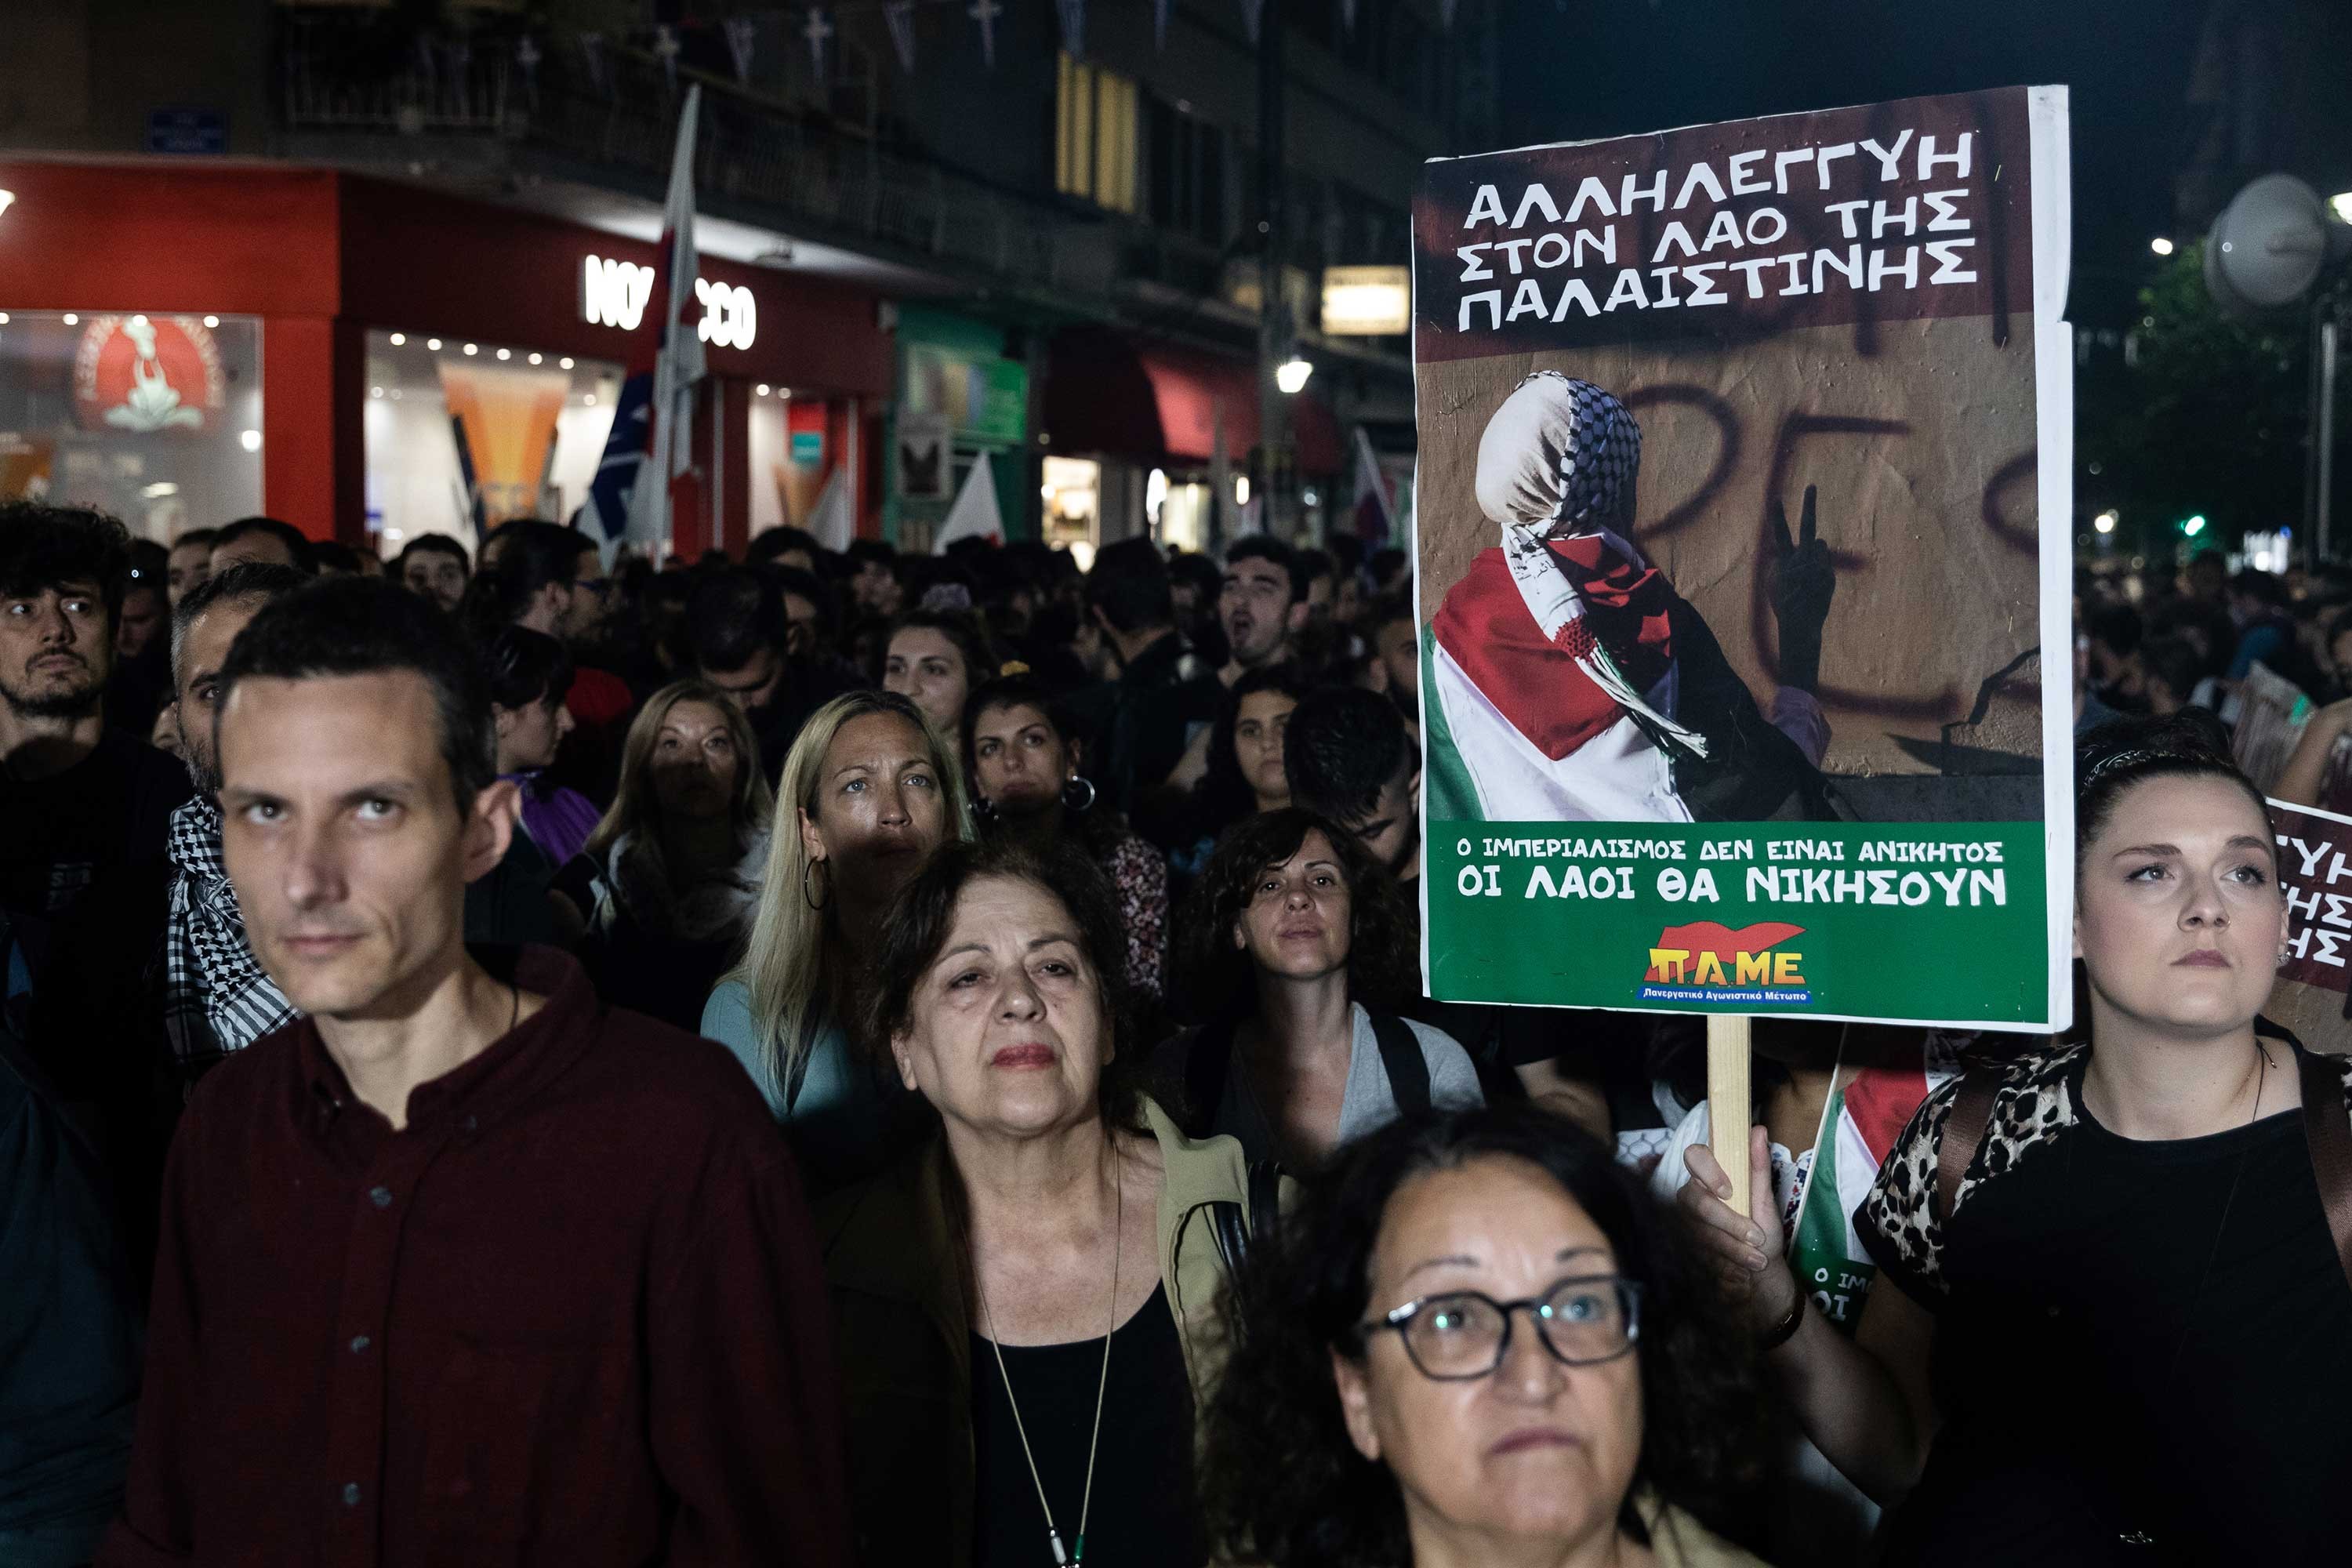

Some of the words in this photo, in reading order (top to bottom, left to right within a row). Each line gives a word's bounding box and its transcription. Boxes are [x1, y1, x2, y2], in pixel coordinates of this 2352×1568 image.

[1463, 129, 1973, 230] ΑΛΛΗΛΕΓΓΥΗ
[1457, 224, 1617, 282] ΣΤΟΝ
[1652, 207, 1788, 263] ΛΑΟ
[1824, 188, 1971, 239] ΤΗΣ
[1458, 238, 1977, 332] ΠΑΛΑΙΣΤΙΝΗΣ
[1457, 838, 1472, 857] Ο
[1483, 838, 1686, 860] ΙΜΠΕΡΙΑΛΙΣΜΟΣ
[1699, 839, 1754, 861] ΔΕΝ
[1766, 839, 1845, 862] ΕΙΝΑΙ
[1858, 840, 2003, 863] ΑΝΙΚΗΤΟΣ
[2275, 834, 2352, 885] ΥΗ
[1457, 864, 1501, 897] ΟΙ
[1524, 865, 1635, 899] ΛΑΟΙ
[1657, 867, 1720, 903] ΘΑ
[1746, 866, 2007, 907] ΝΙΚΗΣΟΥΝ
[2280, 881, 2352, 930] ΗΣ
[1644, 988, 1703, 1000] Πανεργατικό
[1706, 991, 1762, 1002] Αγωνιστικό
[1765, 991, 1806, 1001] Μέτωπο
[1814, 1267, 1829, 1283] Ο
[1838, 1272, 1874, 1293] ΙΜ
[1812, 1290, 1850, 1321] ΟΙ
